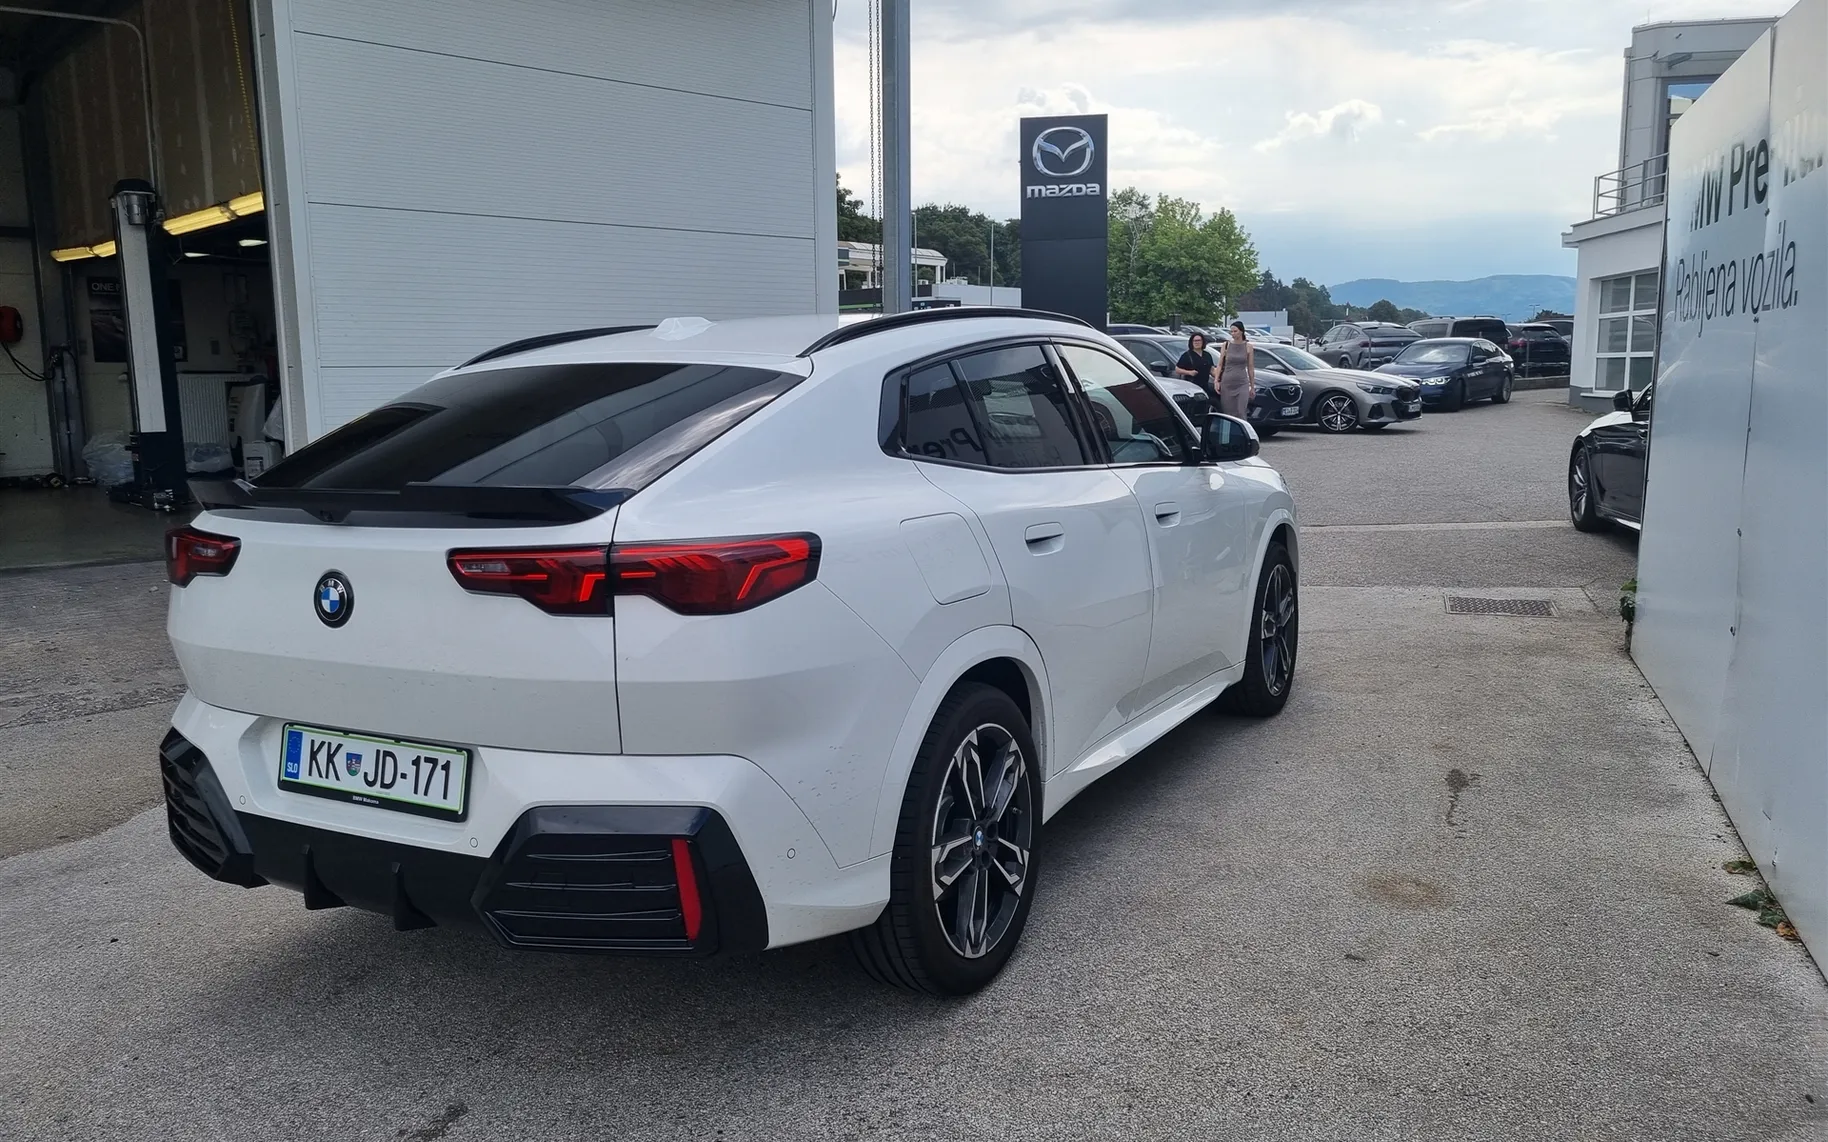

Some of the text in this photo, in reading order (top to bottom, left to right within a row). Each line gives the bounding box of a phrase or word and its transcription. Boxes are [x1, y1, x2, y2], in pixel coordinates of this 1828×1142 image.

[1026, 183, 1100, 199] mazda
[1675, 220, 1799, 338] Rabljena vozila.
[320, 580, 344, 594] BMW
[287, 761, 299, 774] SLO
[309, 739, 451, 799] KK JD-171
